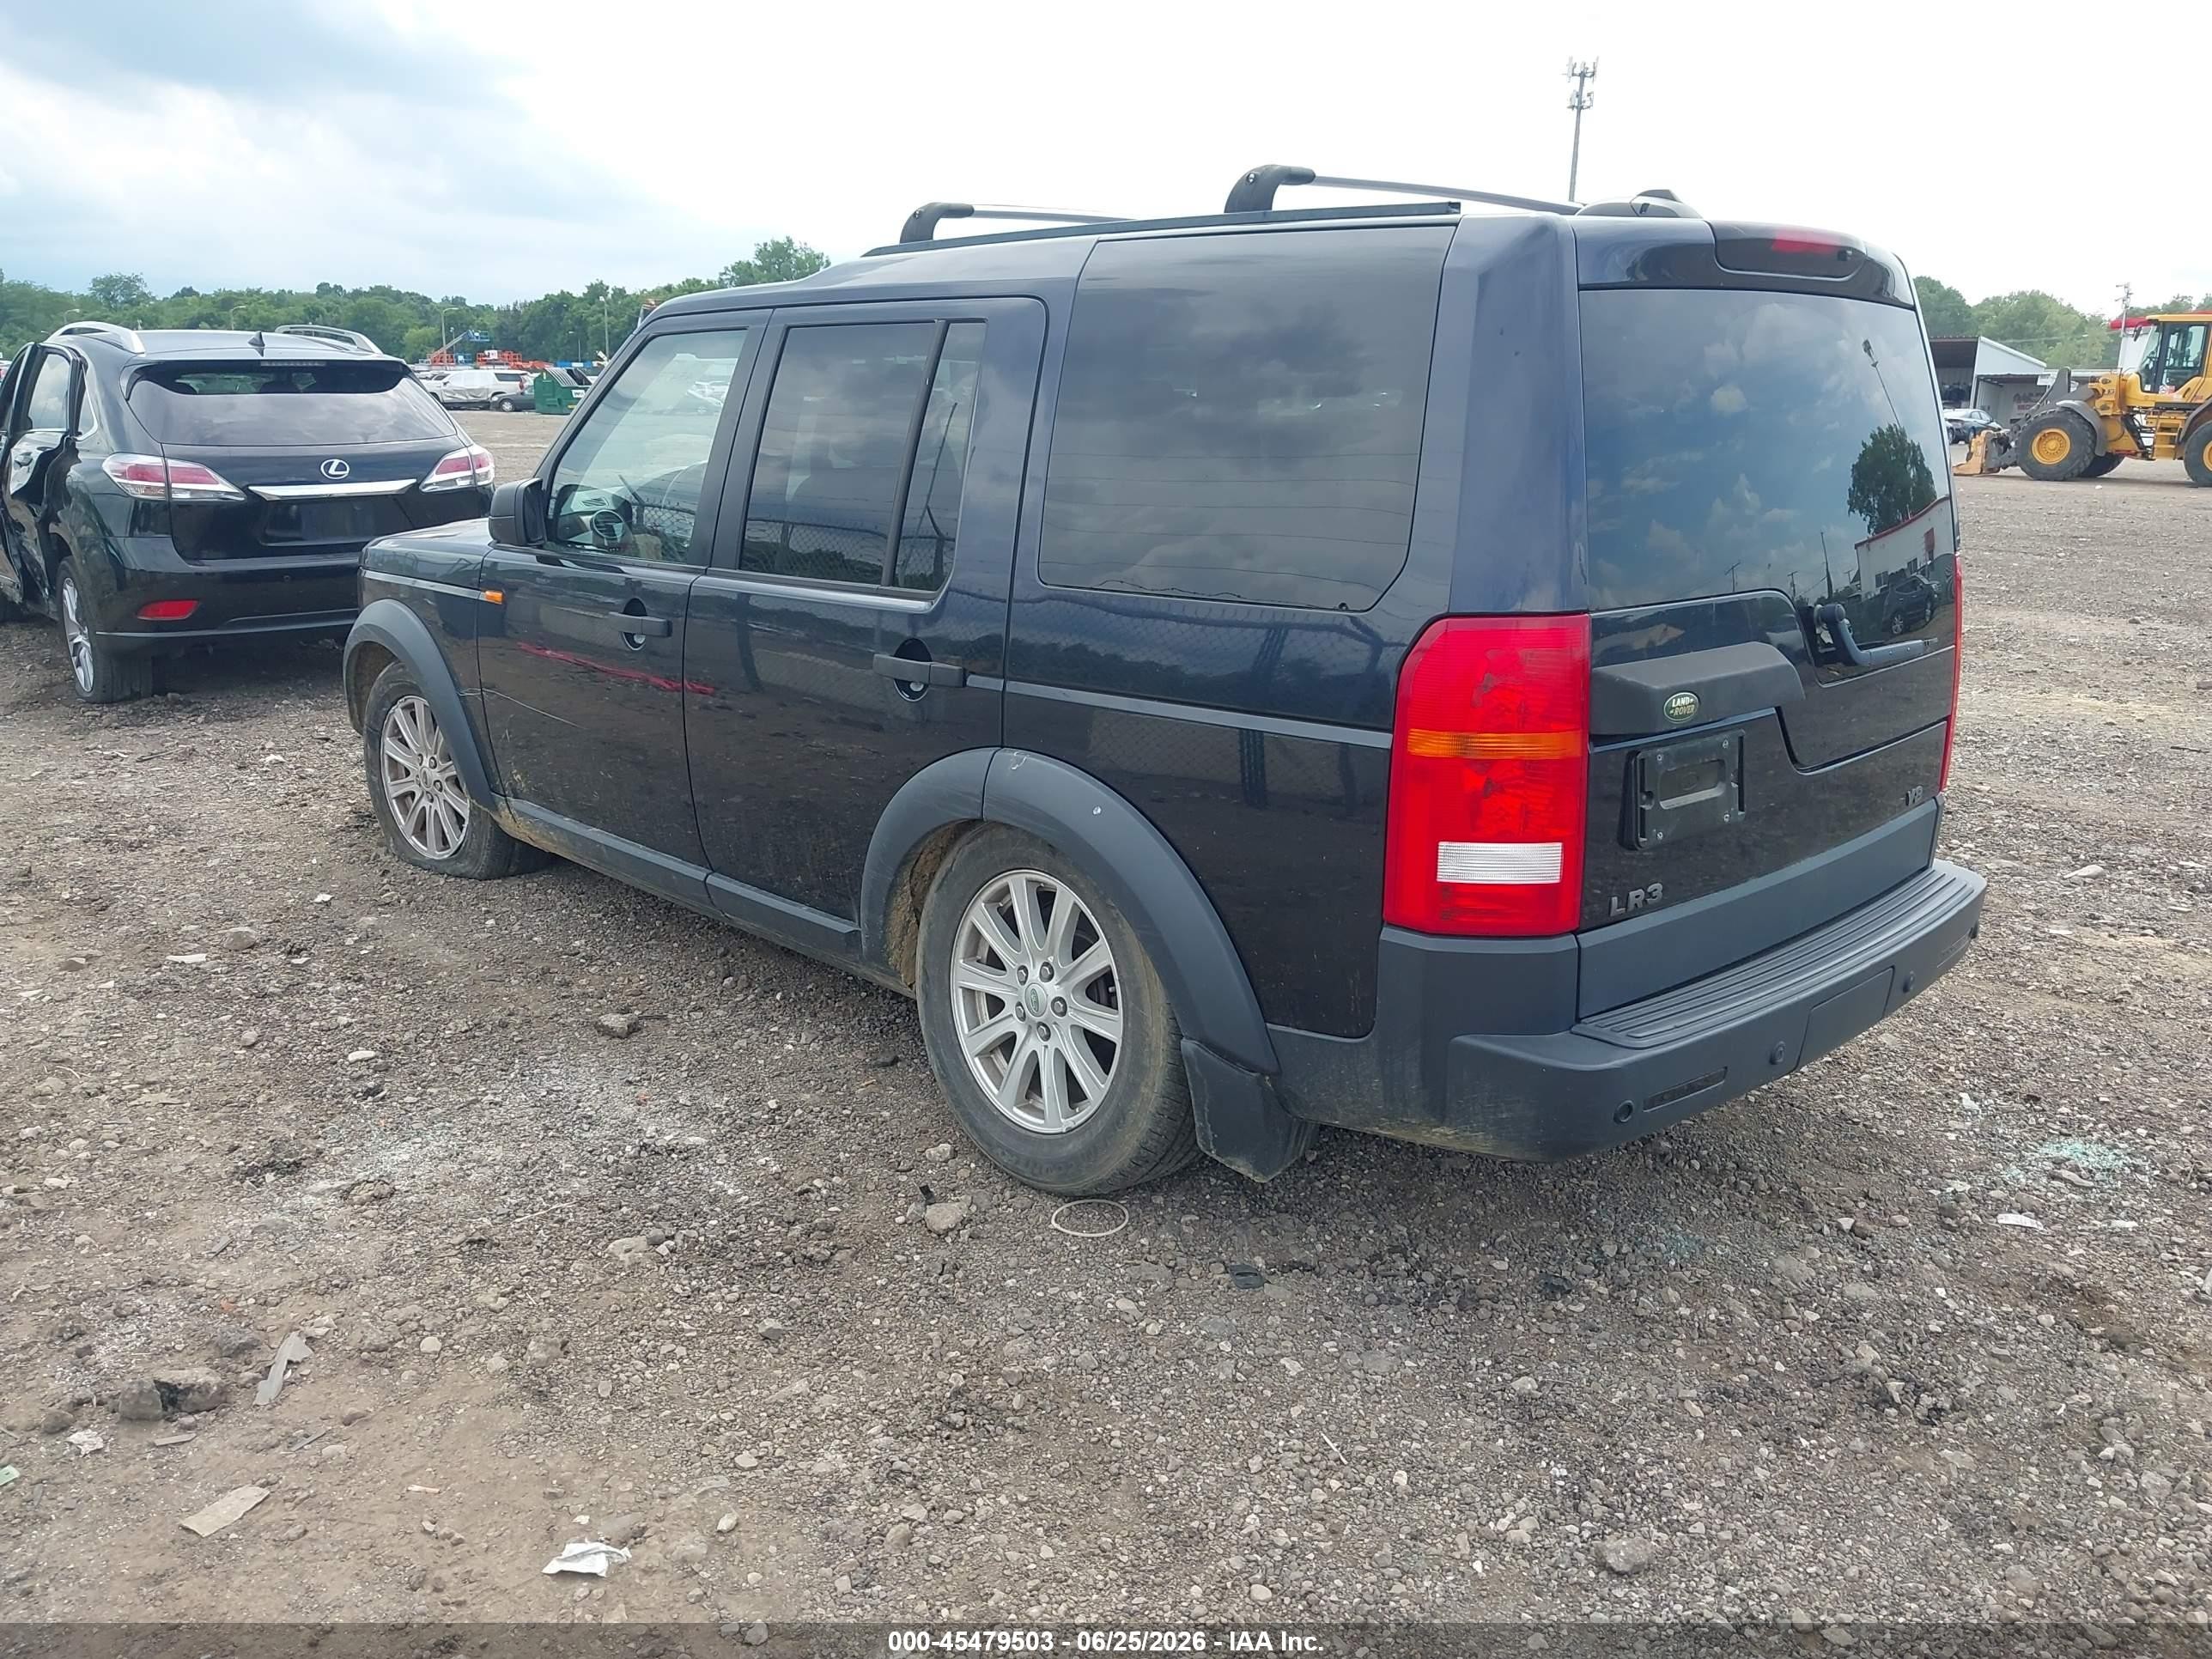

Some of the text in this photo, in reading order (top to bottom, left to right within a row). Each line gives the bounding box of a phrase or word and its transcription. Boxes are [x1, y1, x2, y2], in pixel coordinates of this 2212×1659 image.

[1672, 696, 1690, 708] LAND
[1674, 704, 1695, 716] ROVER
[1609, 883, 1663, 917] LR3
